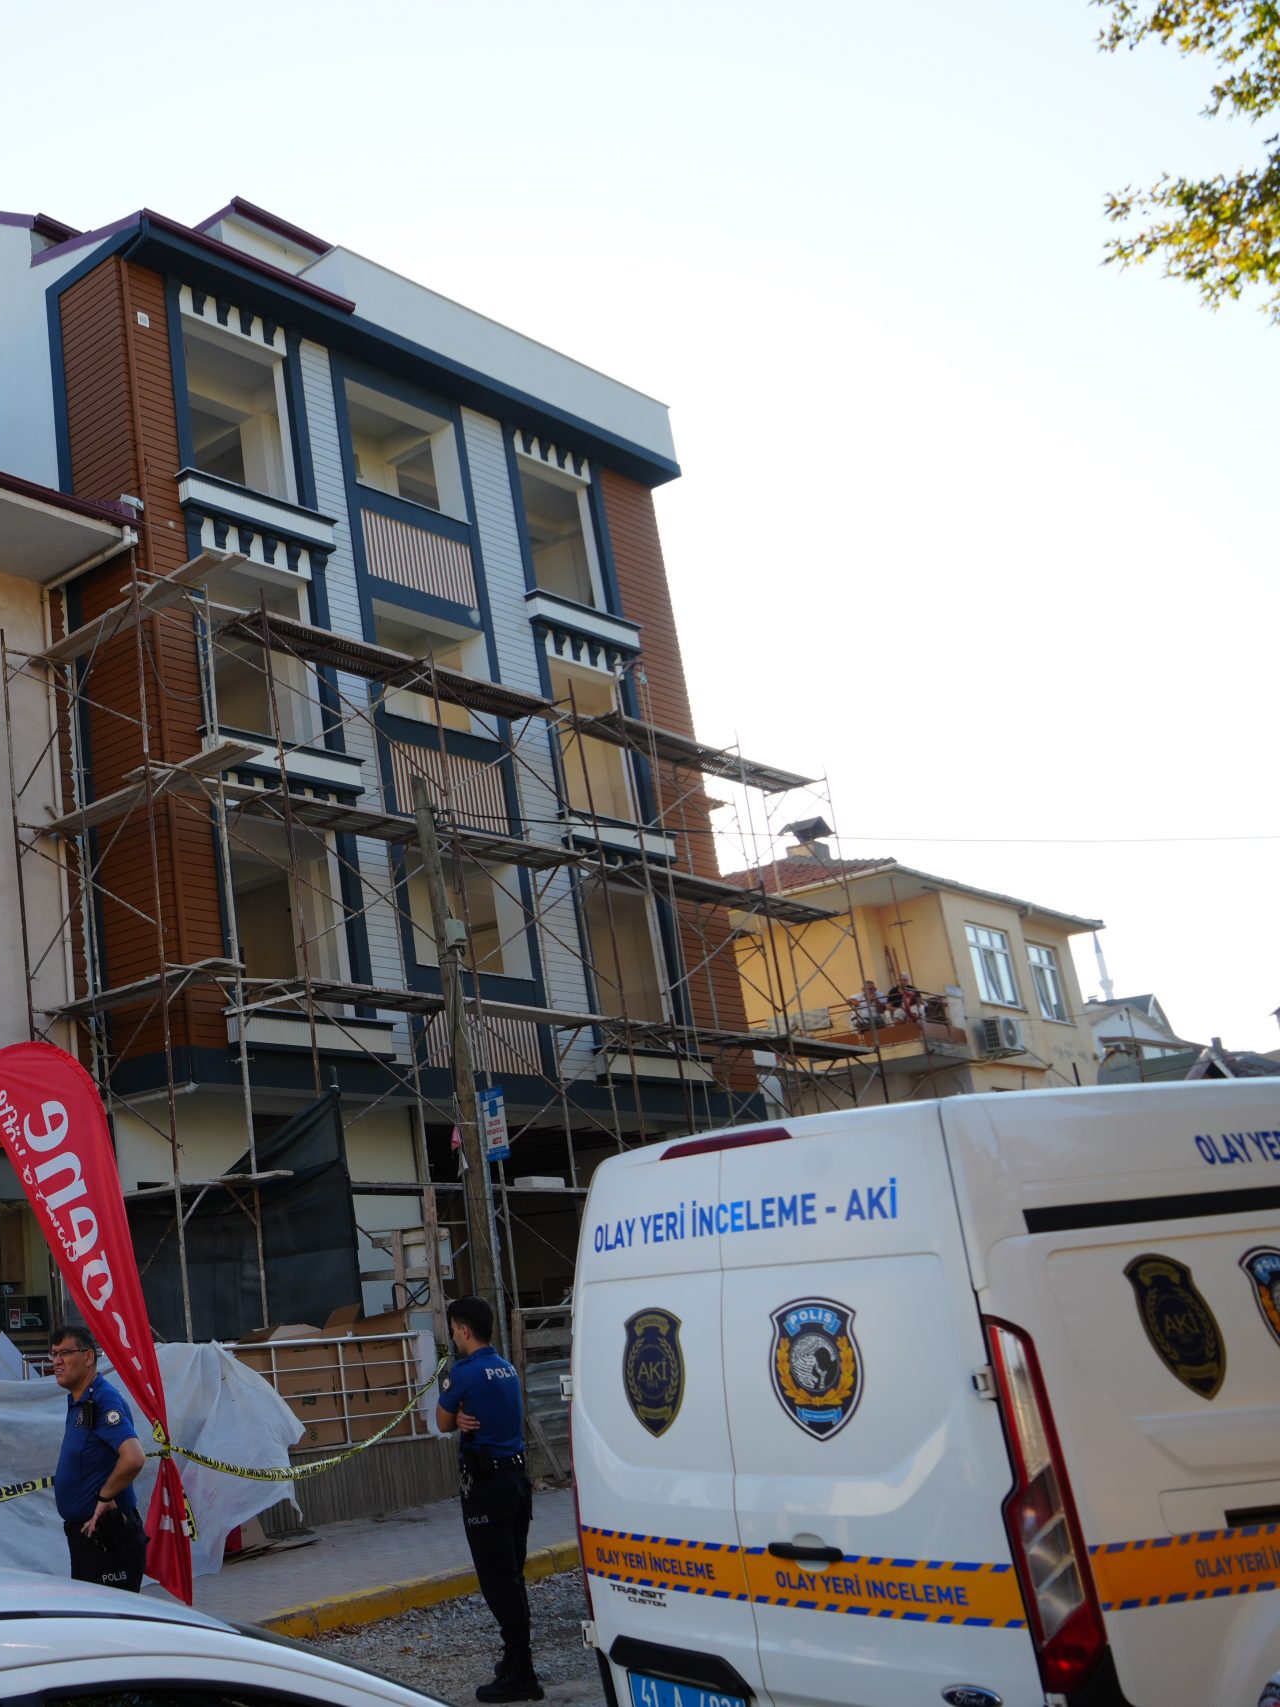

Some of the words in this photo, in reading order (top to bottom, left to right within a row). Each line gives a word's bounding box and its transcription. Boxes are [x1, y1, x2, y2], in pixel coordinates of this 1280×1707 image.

[1195, 1132, 1252, 1165] OLAY
[594, 1218, 636, 1253] OLAY
[640, 1202, 685, 1244] YERİ
[691, 1192, 817, 1238] İNCELEME
[845, 1177, 898, 1222] AKİ
[788, 1308, 832, 1325] POLİS
[637, 1359, 668, 1381] AKİ
[596, 1547, 620, 1565] OLAY
[621, 1549, 647, 1570] YERİ
[648, 1552, 716, 1581] İNCELEME
[1195, 1553, 1233, 1579] OLAY
[1234, 1545, 1270, 1574] YERİ
[609, 1583, 666, 1600] TRANSIT
[776, 1571, 817, 1592] OLAY
[820, 1574, 862, 1597] YERİ
[628, 1596, 667, 1608] CUSTOM
